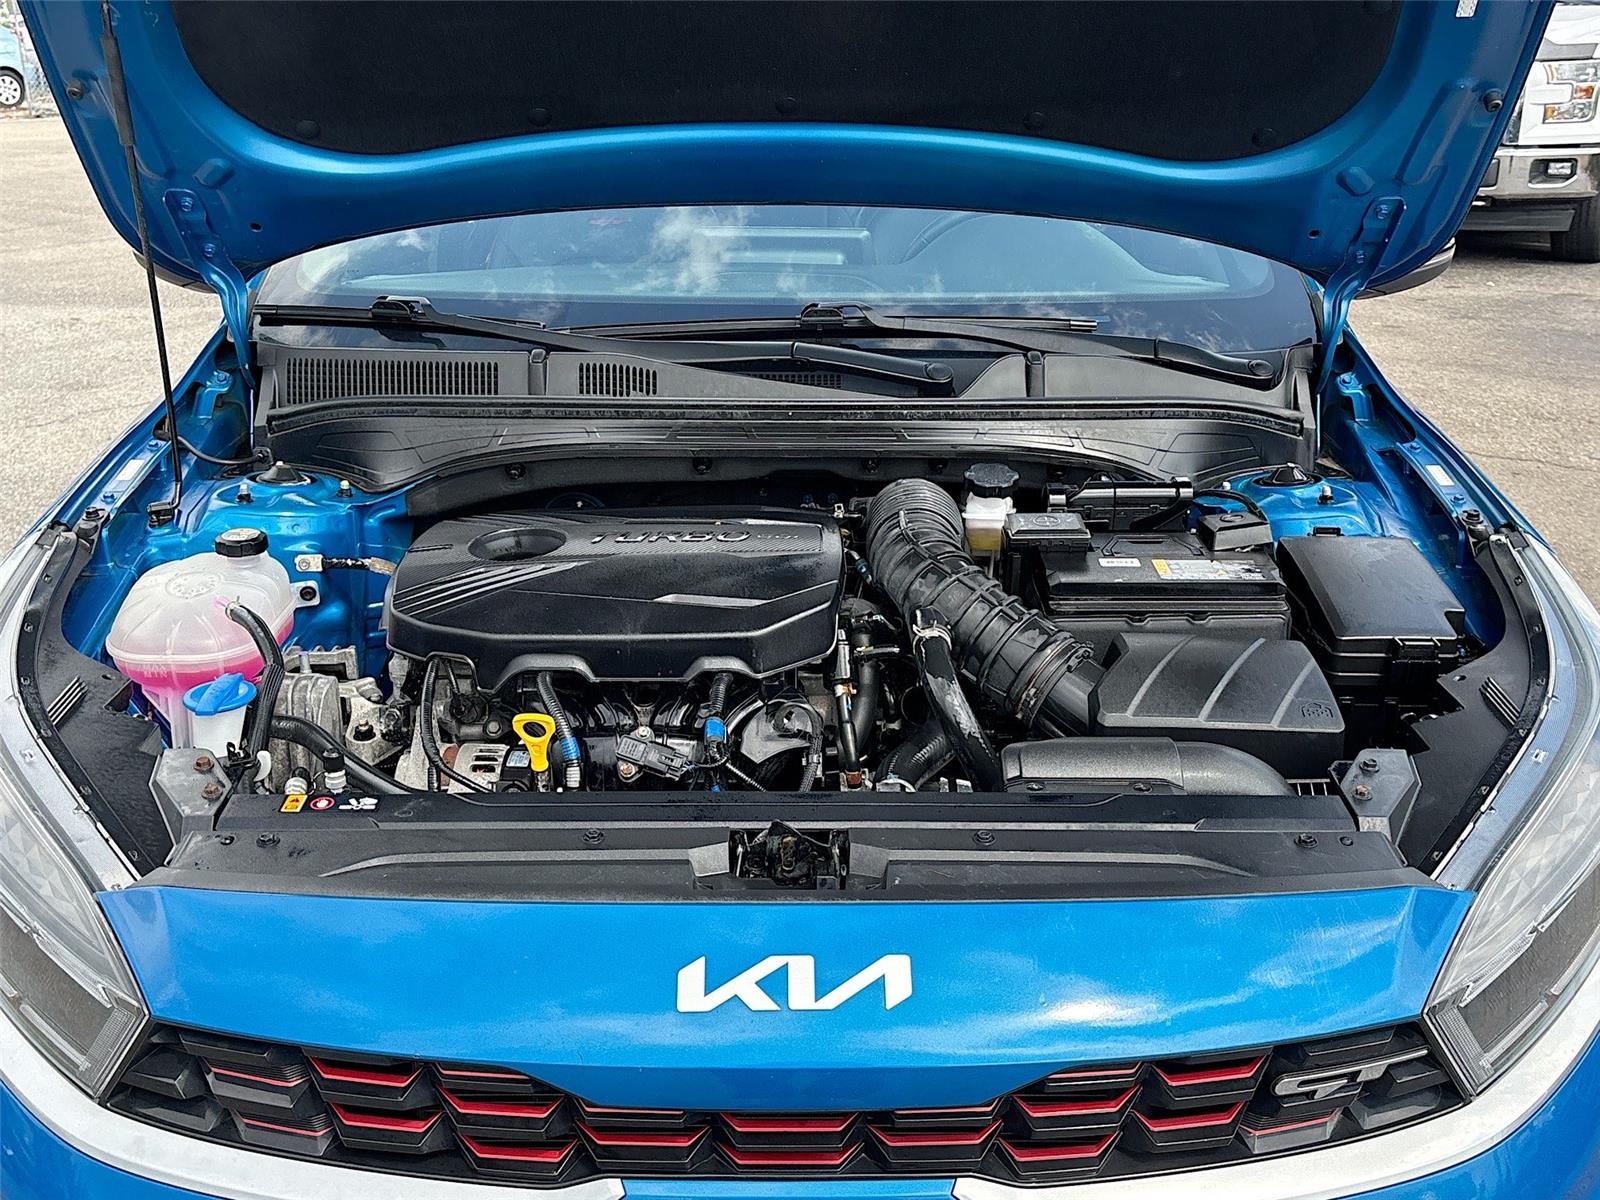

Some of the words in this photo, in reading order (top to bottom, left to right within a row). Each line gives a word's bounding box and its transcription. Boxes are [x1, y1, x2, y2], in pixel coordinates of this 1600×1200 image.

[590, 530, 752, 544] TURBO
[676, 953, 913, 1013] KIA
[1271, 1045, 1431, 1100] GT
